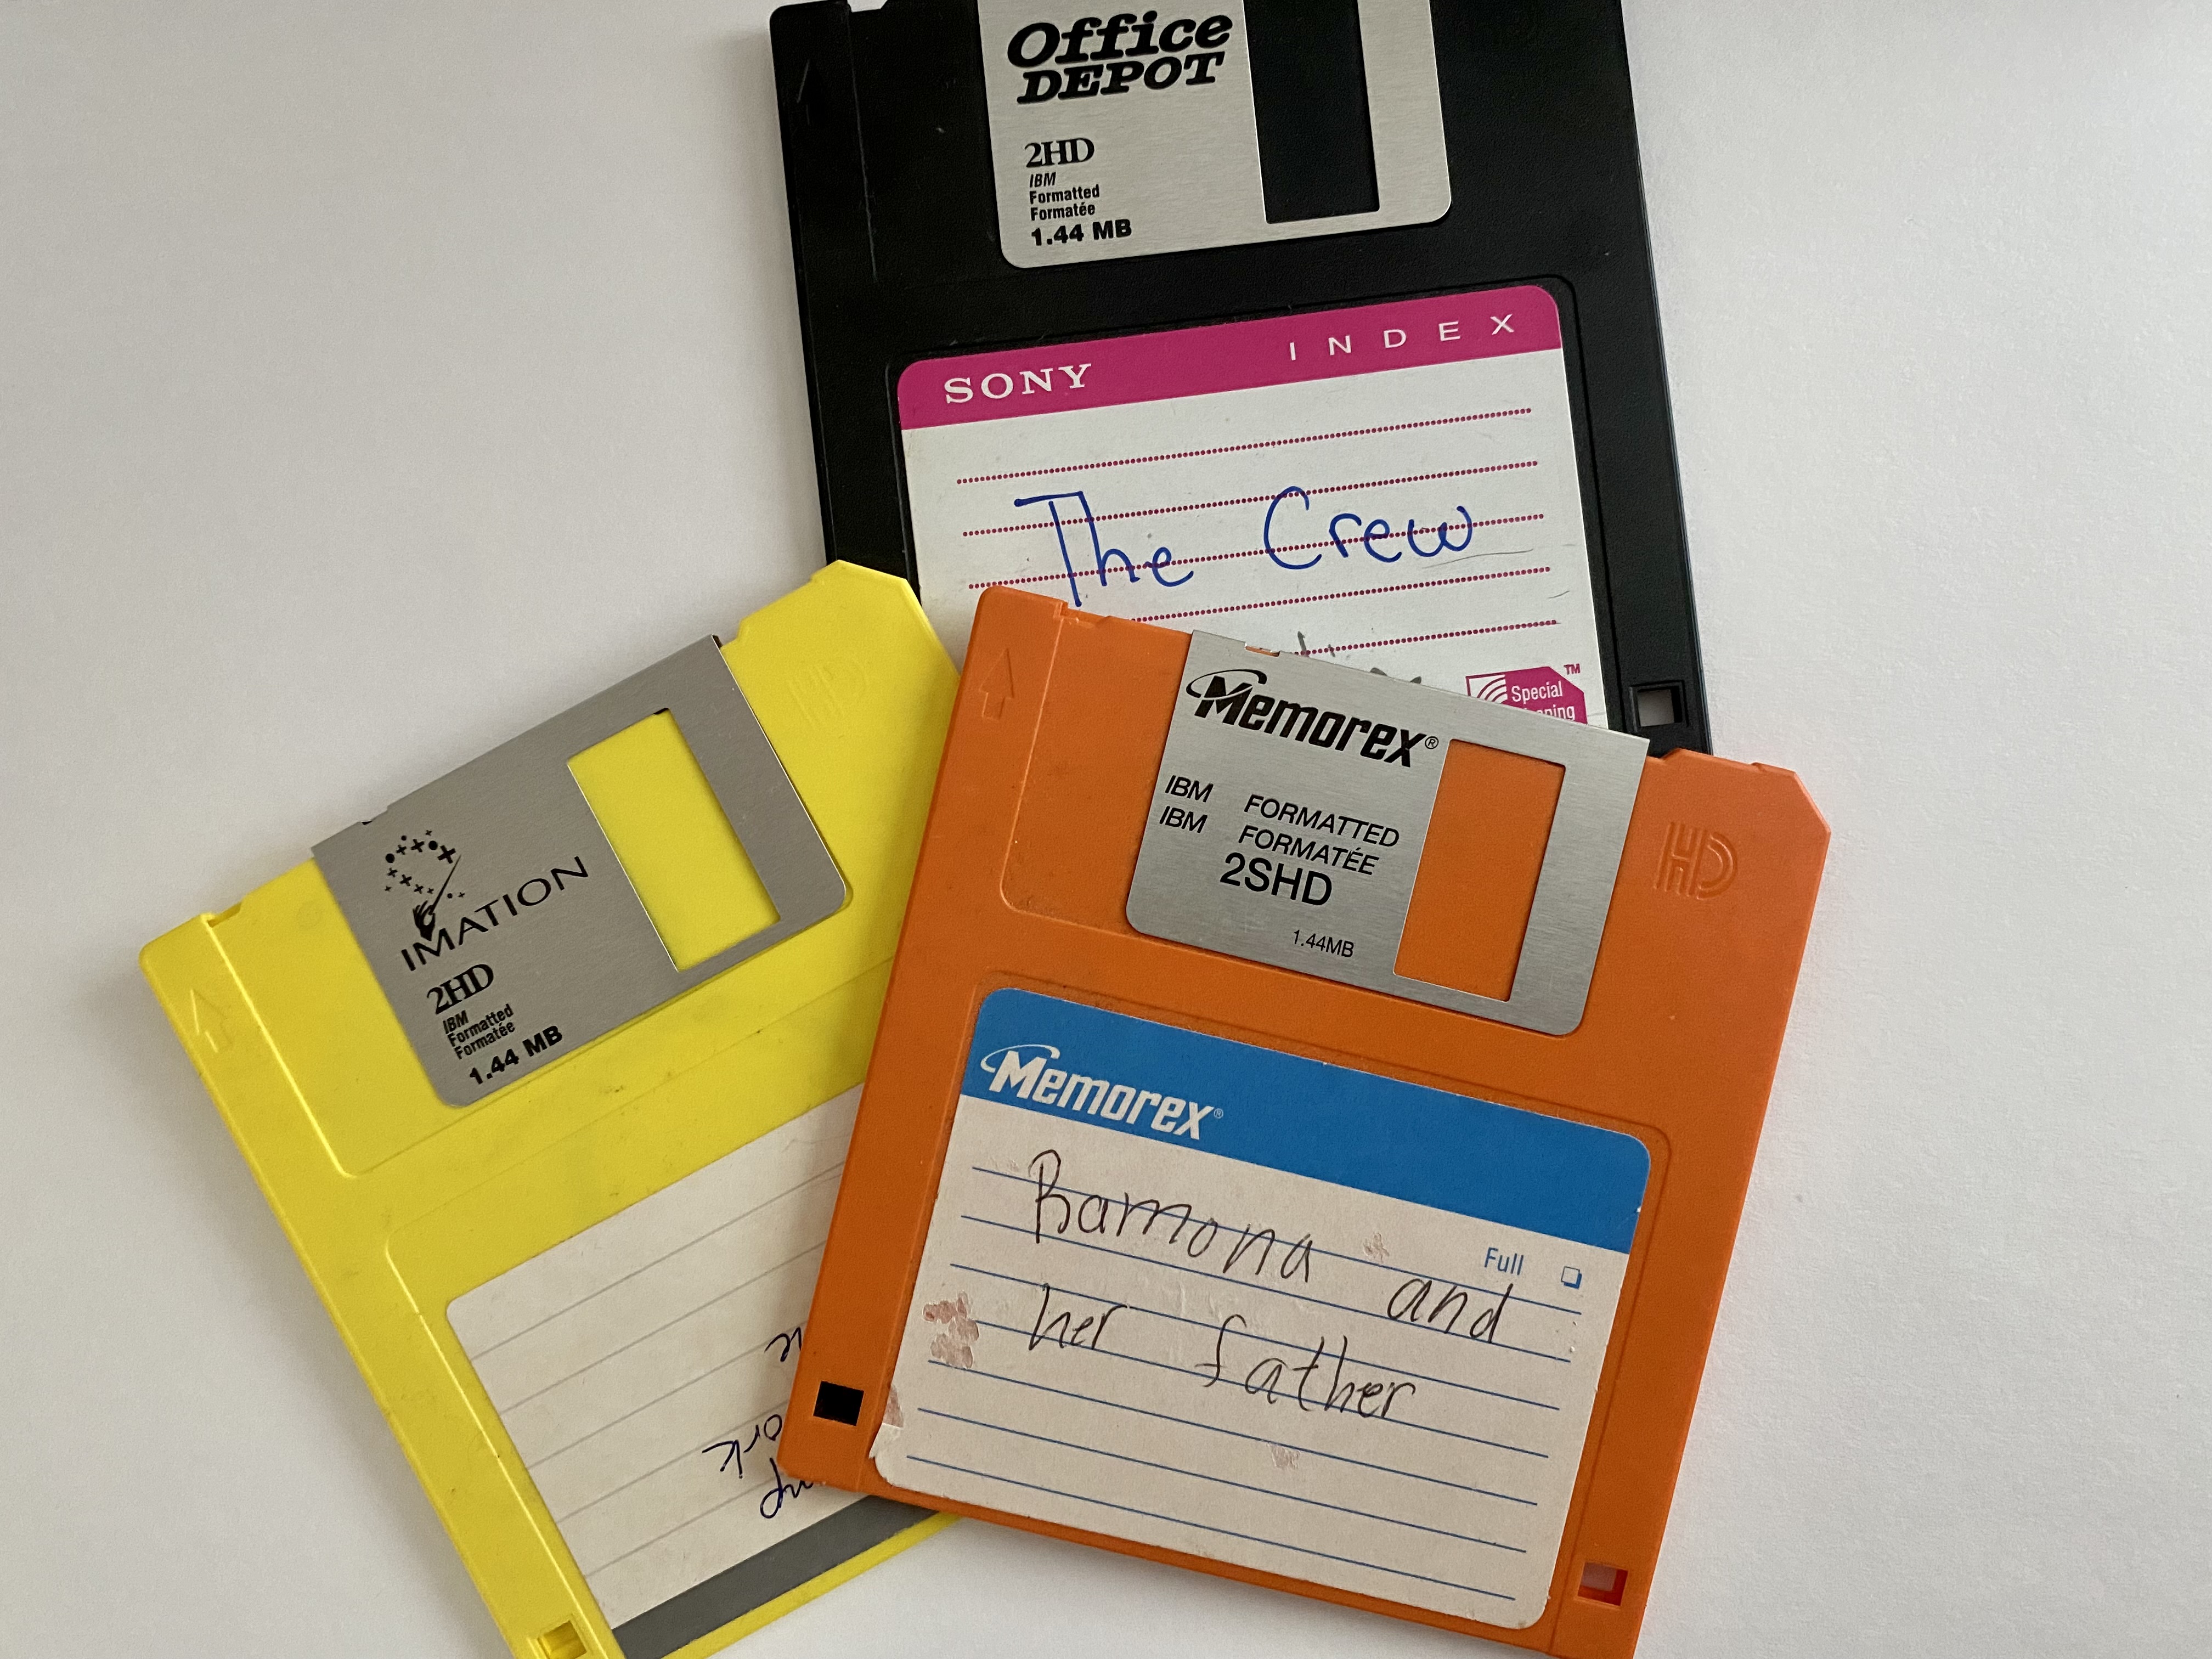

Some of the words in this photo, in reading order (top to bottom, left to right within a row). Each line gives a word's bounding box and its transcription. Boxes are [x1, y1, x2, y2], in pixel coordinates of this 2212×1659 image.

[1007, 11, 1233, 67] Office
[1016, 51, 1226, 104] DEPOT
[1024, 138, 1094, 168] 2HD
[1029, 172, 1056, 188] IBM
[1030, 184, 1100, 205] Formatted
[1030, 202, 1096, 221] Formatée
[1031, 224, 1084, 246] 1.44
[1093, 219, 1132, 240] MB
[944, 363, 1092, 403] SONY
[1289, 313, 1515, 361] INDEX
[1014, 491, 1193, 607] The
[1263, 486, 1473, 569] Crew
[1511, 680, 1562, 704] Special
[1165, 775, 1214, 803] IBM
[1243, 794, 1401, 848] FORMATTED
[1159, 805, 1207, 833] IBM
[1238, 825, 1380, 876] FORMATÉE
[1220, 852, 1333, 907] 2SHD
[401, 856, 589, 971] IMATION
[1293, 929, 1354, 958] 1.44MB
[427, 964, 494, 1015] 2HD
[443, 1010, 469, 1034] IBM
[447, 1003, 514, 1047] Formatted
[454, 1020, 516, 1060] Formatée
[469, 1048, 520, 1085] 1.44
[523, 1025, 563, 1057] MB
[1484, 1245, 1523, 1274] Full
[1387, 1278, 1513, 1344] and
[1028, 1284, 1131, 1352] her
[1195, 1314, 1415, 1420] father
[702, 1414, 783, 1479] ork
